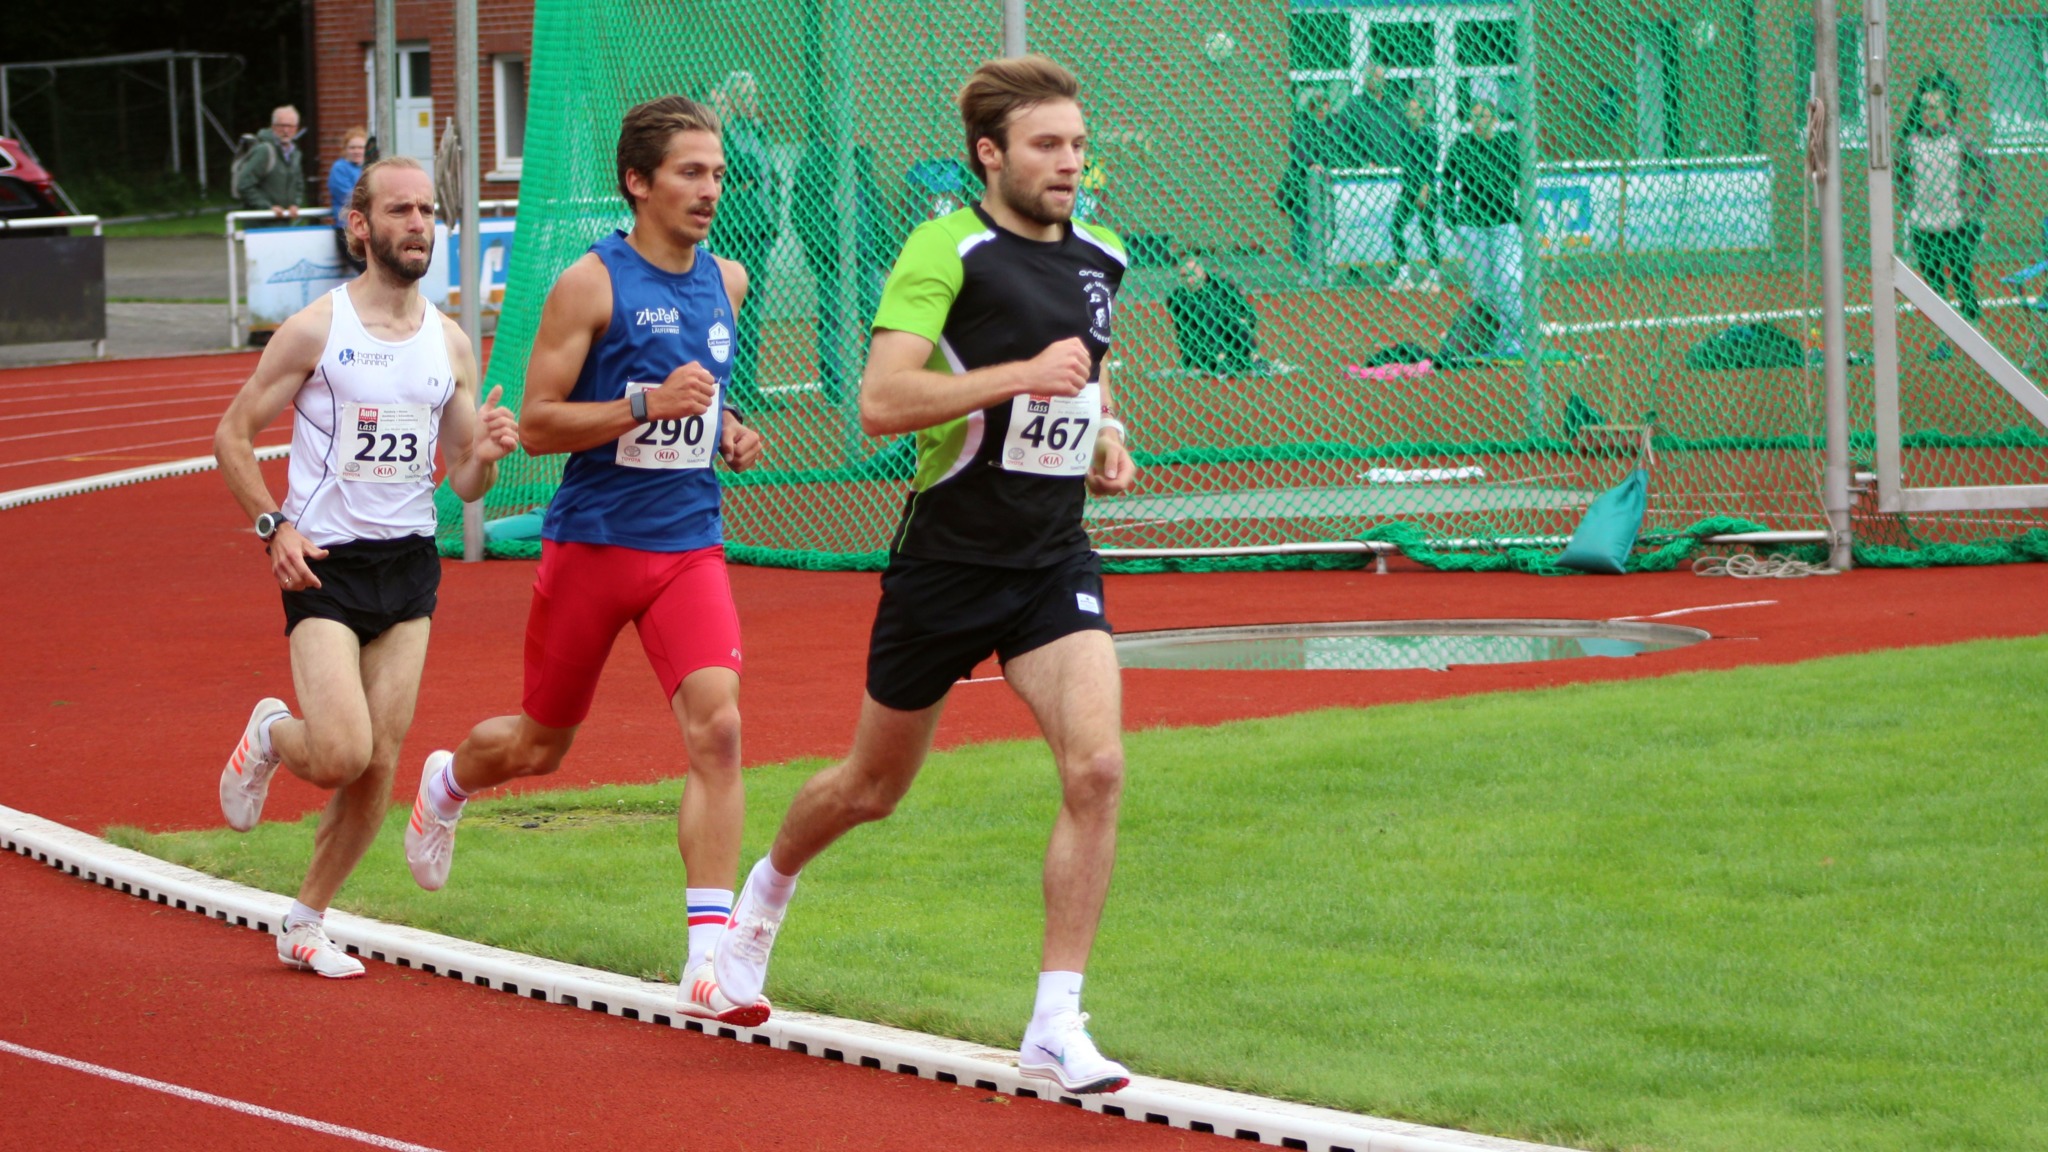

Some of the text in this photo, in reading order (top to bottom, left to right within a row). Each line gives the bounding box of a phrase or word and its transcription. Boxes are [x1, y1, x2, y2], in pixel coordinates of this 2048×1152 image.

[1079, 270, 1104, 278] orca
[357, 351, 394, 361] hamburg
[357, 359, 388, 367] running
[360, 408, 377, 418] Auto
[635, 414, 704, 446] 290
[1020, 415, 1090, 451] 467
[354, 432, 418, 462] 223
[659, 451, 675, 459] KIA
[1043, 455, 1060, 465] KIA
[377, 467, 393, 475] KIA
